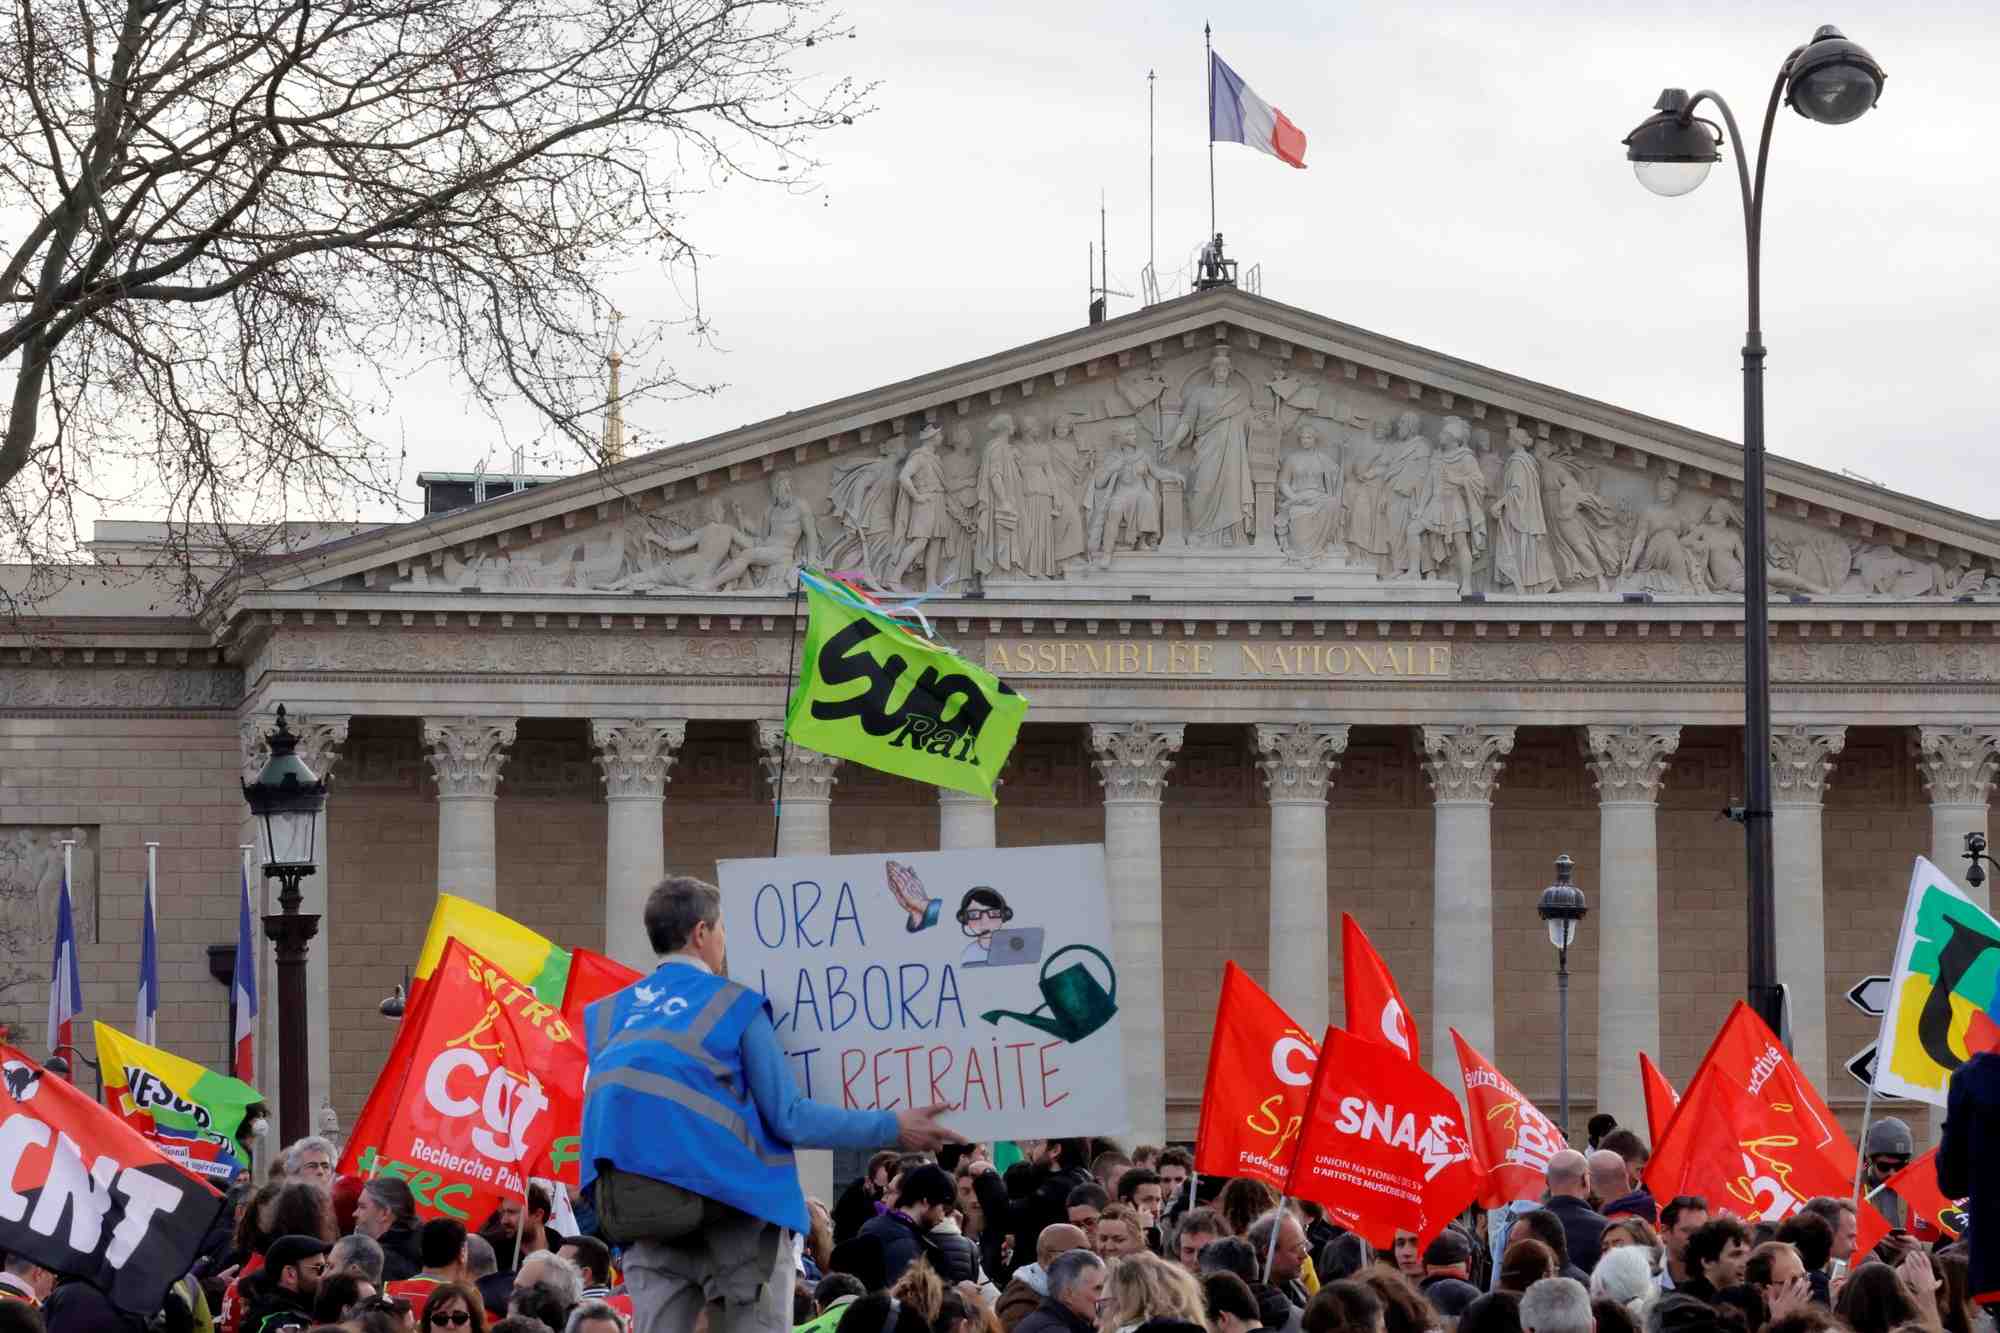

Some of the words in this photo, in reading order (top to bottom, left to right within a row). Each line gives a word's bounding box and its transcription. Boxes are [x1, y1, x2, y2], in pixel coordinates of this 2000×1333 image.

[990, 641, 1214, 674] ASSEMBLÉE
[1240, 644, 1450, 677] NATIONALE
[754, 881, 866, 949] ORA
[760, 963, 967, 1033] LABORA
[783, 1047, 822, 1100] T
[410, 1137, 493, 1182] Recherche
[495, 1166, 525, 1193] Pub
[1312, 1165, 1363, 1187] D'ARTISTES
[1314, 1153, 1351, 1169] UNION
[0, 1112, 184, 1271] CNT
